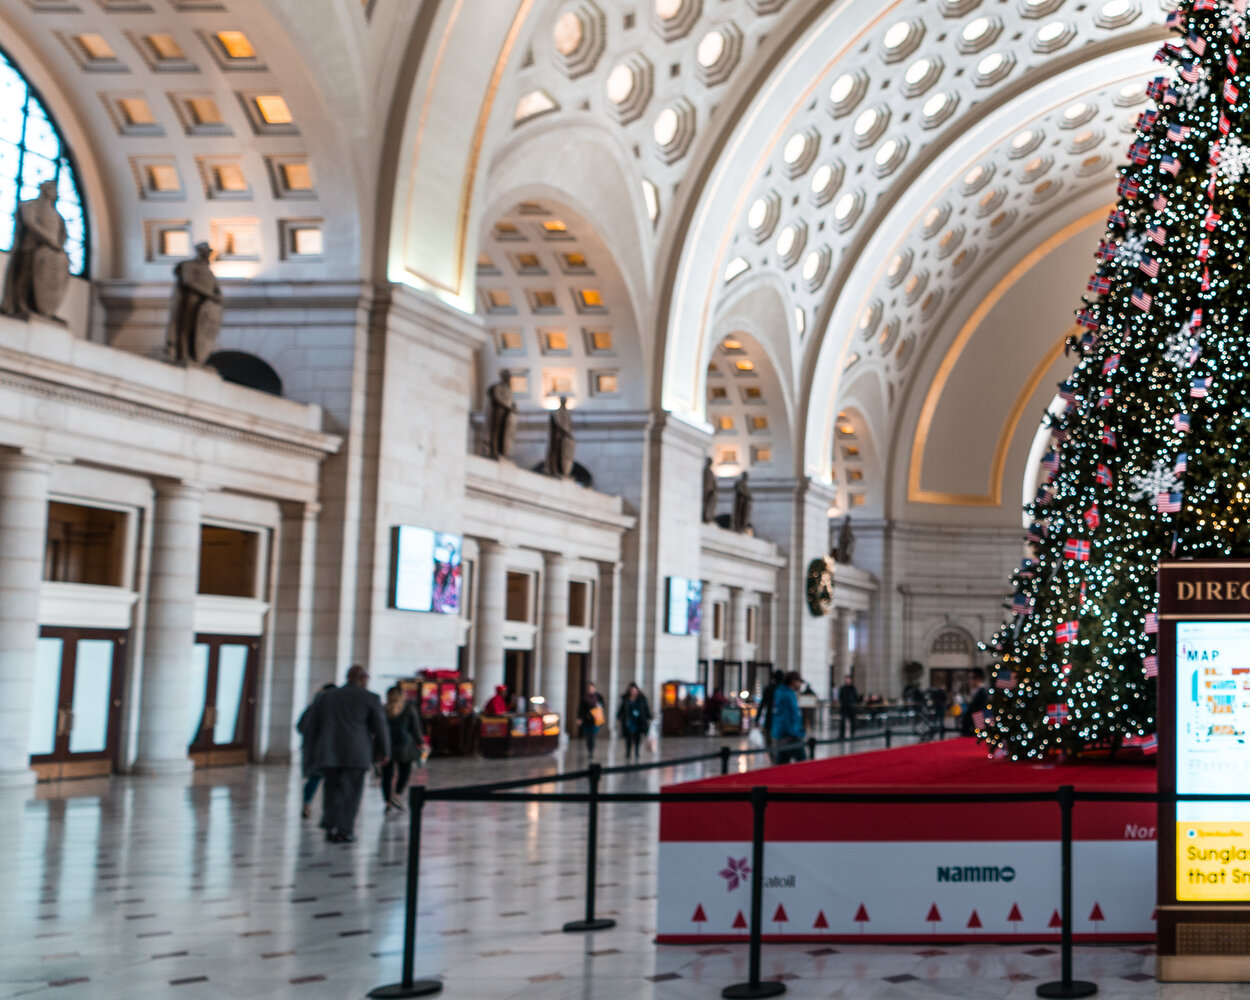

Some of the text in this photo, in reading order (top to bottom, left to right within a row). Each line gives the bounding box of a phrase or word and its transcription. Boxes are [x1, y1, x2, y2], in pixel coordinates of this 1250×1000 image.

[1186, 650, 1220, 661] MAP
[1123, 823, 1156, 839] Nor
[762, 875, 796, 888] atoil
[1187, 867, 1226, 885] that
